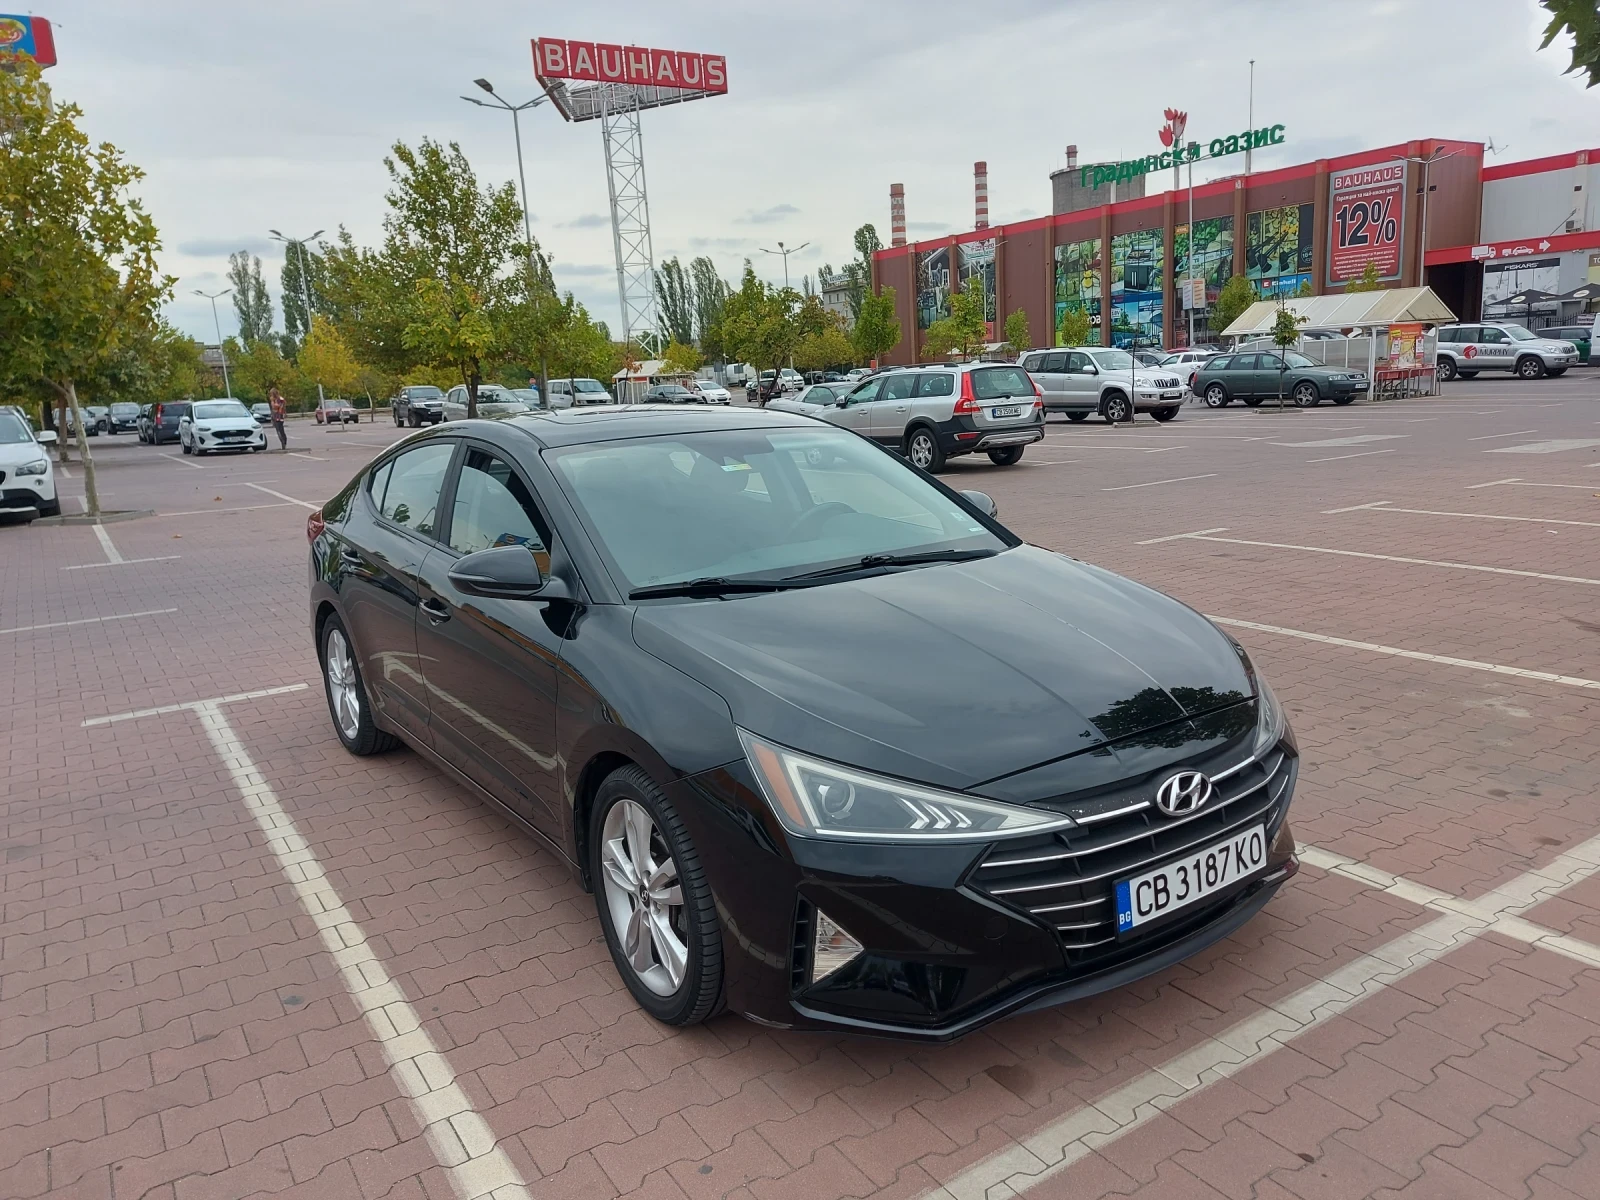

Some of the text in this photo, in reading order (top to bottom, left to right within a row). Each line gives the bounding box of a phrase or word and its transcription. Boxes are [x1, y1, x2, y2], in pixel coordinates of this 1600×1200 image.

[544, 43, 725, 86] BAUHAUS
[1081, 124, 1286, 190] Градински оазис
[1335, 166, 1402, 188] BAUHAUS
[1335, 196, 1397, 249] 12%
[1504, 262, 1538, 271] FISKARS
[1480, 348, 1509, 356] MURPHY
[1136, 832, 1262, 917] CB 3187 KO
[1119, 911, 1132, 925] BG
